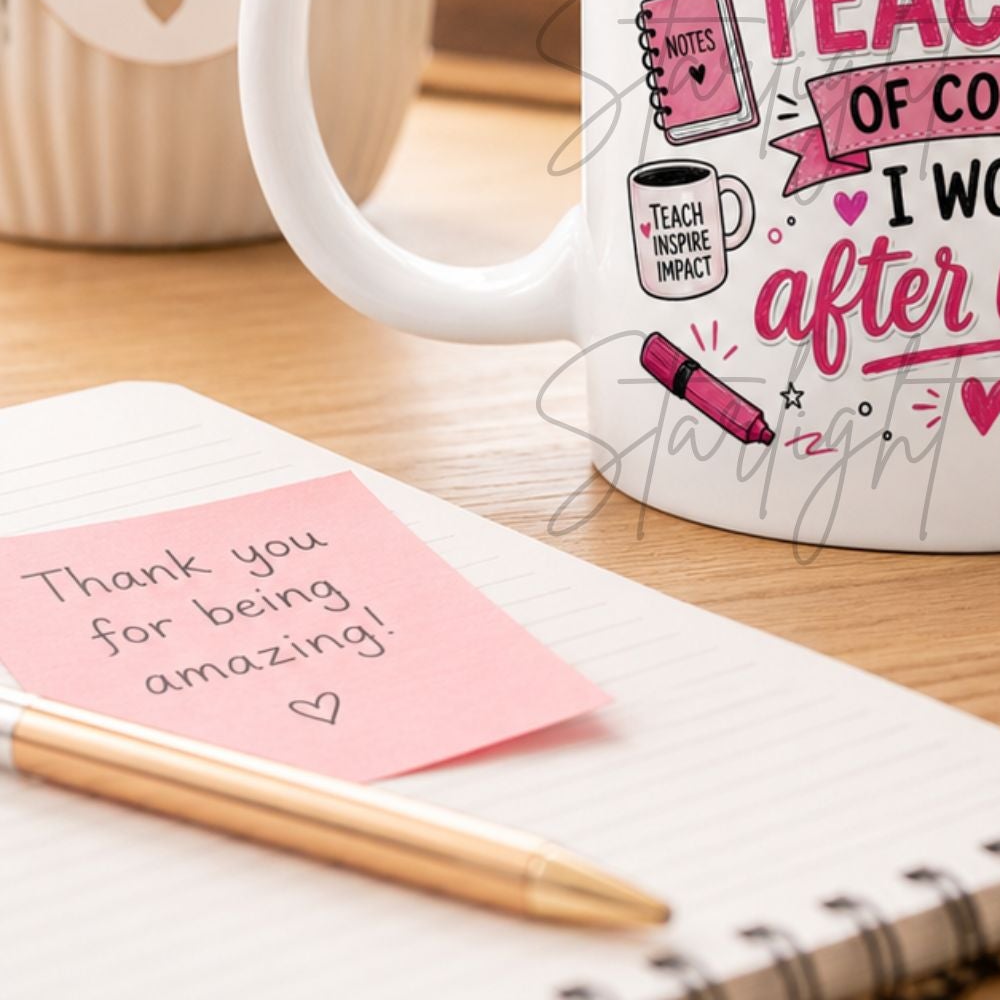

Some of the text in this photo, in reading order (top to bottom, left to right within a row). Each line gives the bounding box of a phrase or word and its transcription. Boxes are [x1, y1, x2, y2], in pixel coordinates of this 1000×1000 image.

[664, 28, 717, 59] NOTES
[849, 78, 910, 134] OF
[649, 202, 704, 230] TEACH
[882, 165, 913, 228] I
[653, 229, 712, 256] INSPIRE
[657, 255, 712, 283] IMPACT
[754, 240, 973, 377] after
[20, 531, 328, 603] Thank you
[91, 579, 351, 657] for being
[145, 606, 395, 695] amazing!
